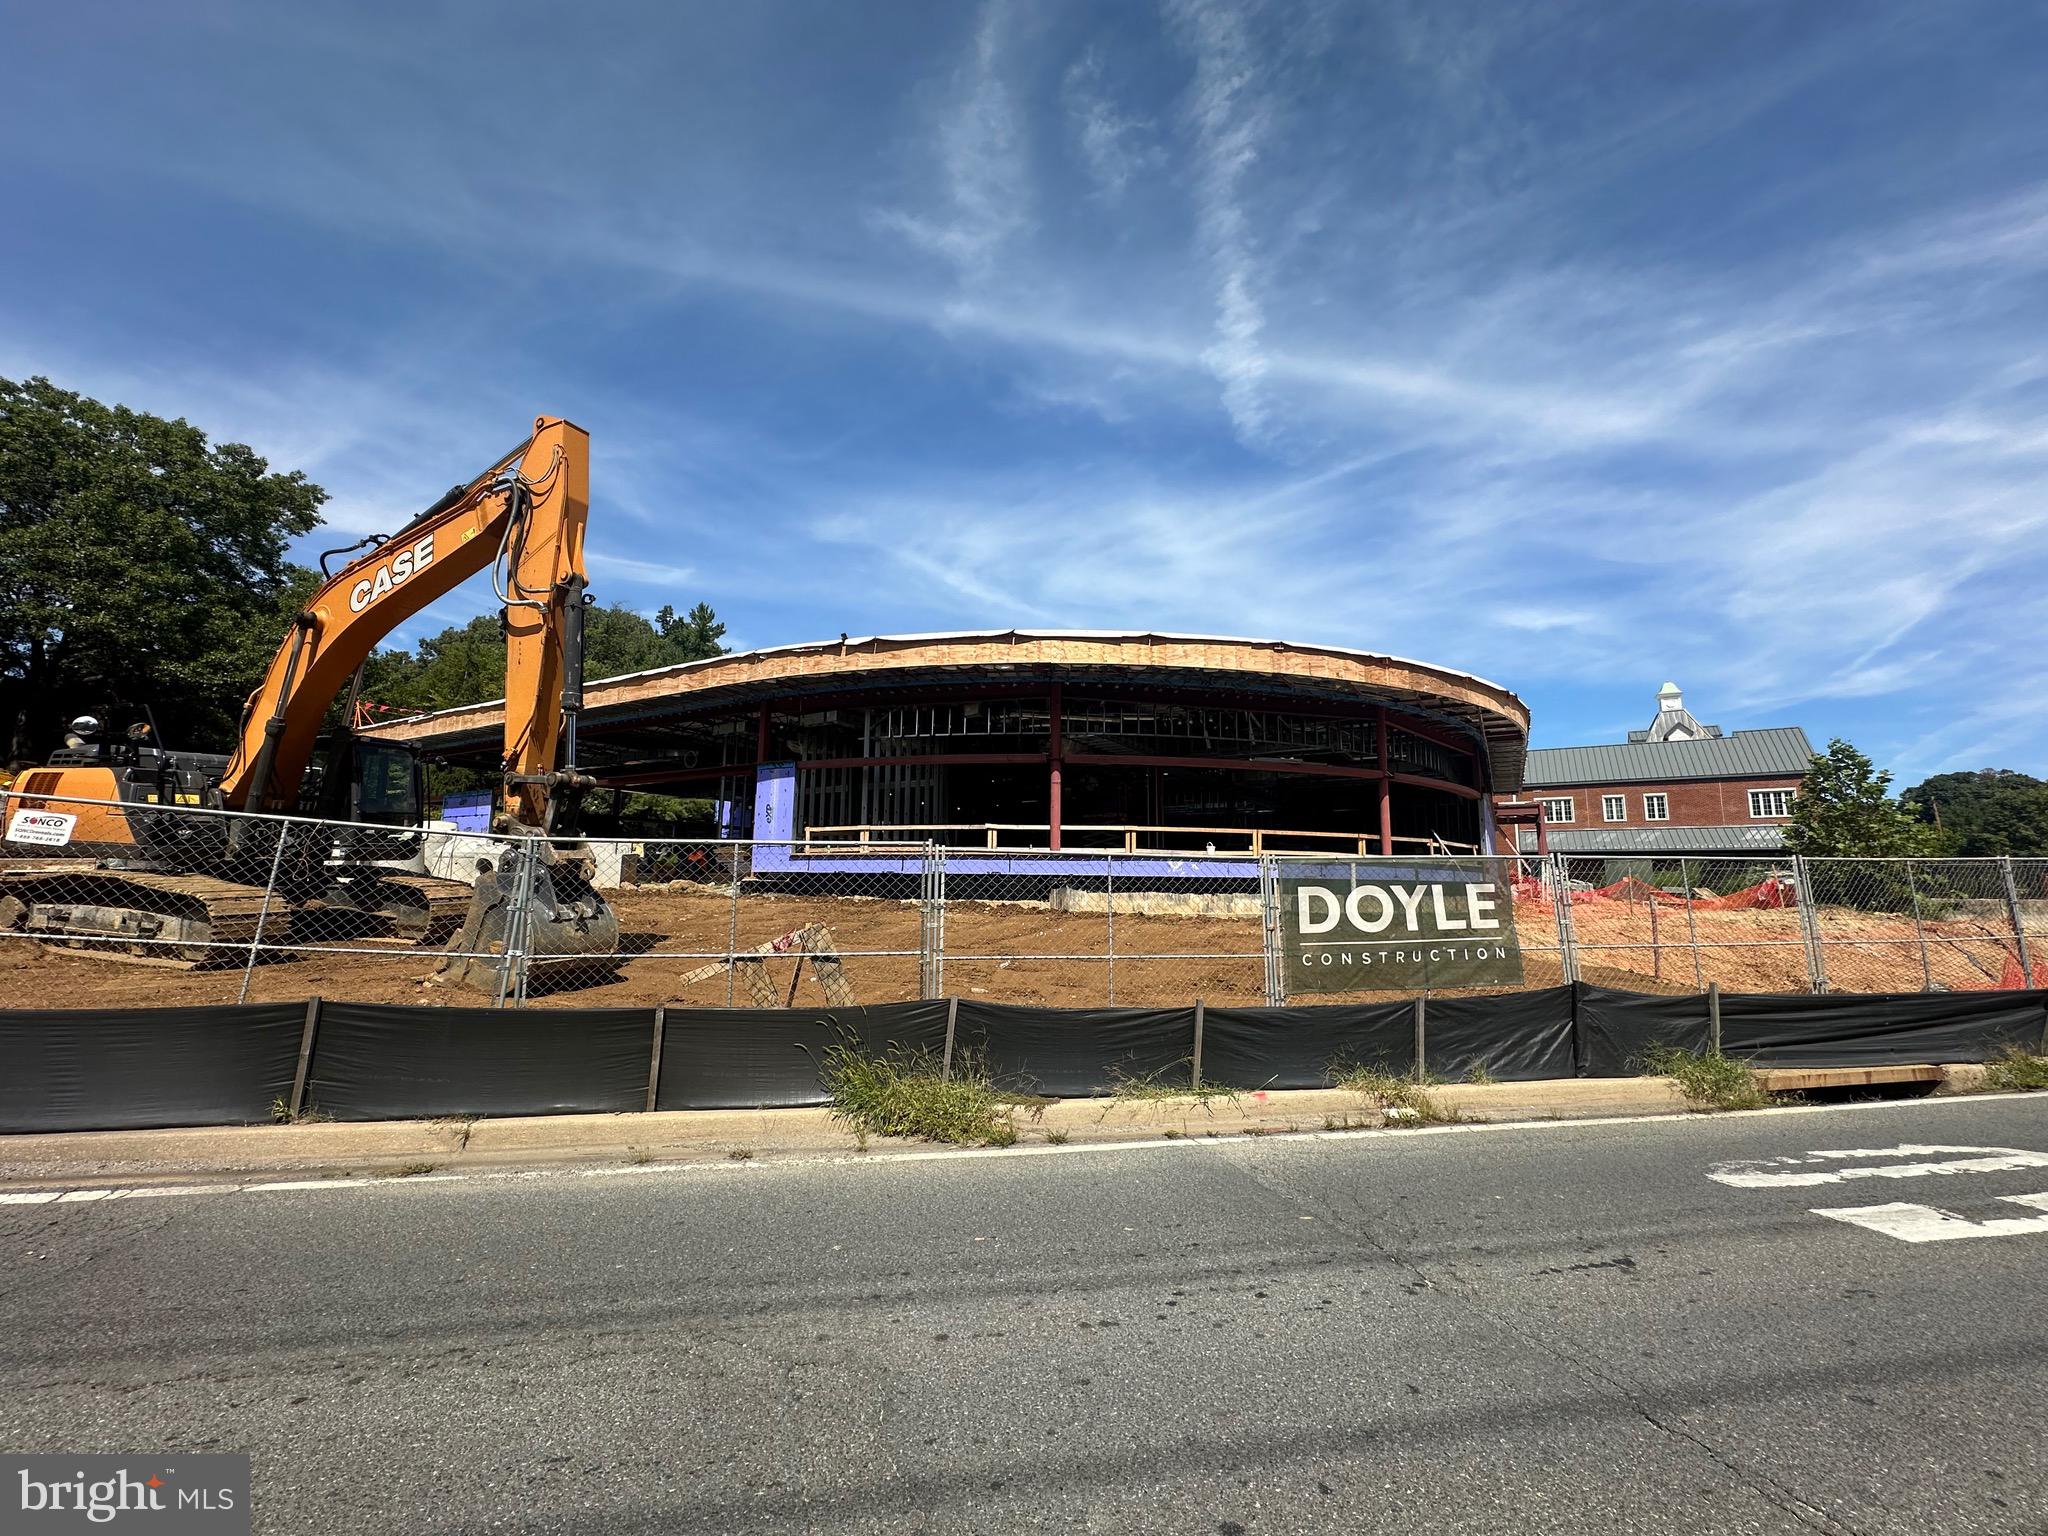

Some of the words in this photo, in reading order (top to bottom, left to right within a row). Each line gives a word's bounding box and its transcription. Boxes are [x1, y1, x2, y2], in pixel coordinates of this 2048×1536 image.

[349, 532, 434, 613] CASE
[22, 816, 64, 827] SONCO
[1297, 884, 1500, 934] DOYLE
[1302, 947, 1506, 967] CONSTRUCTION
